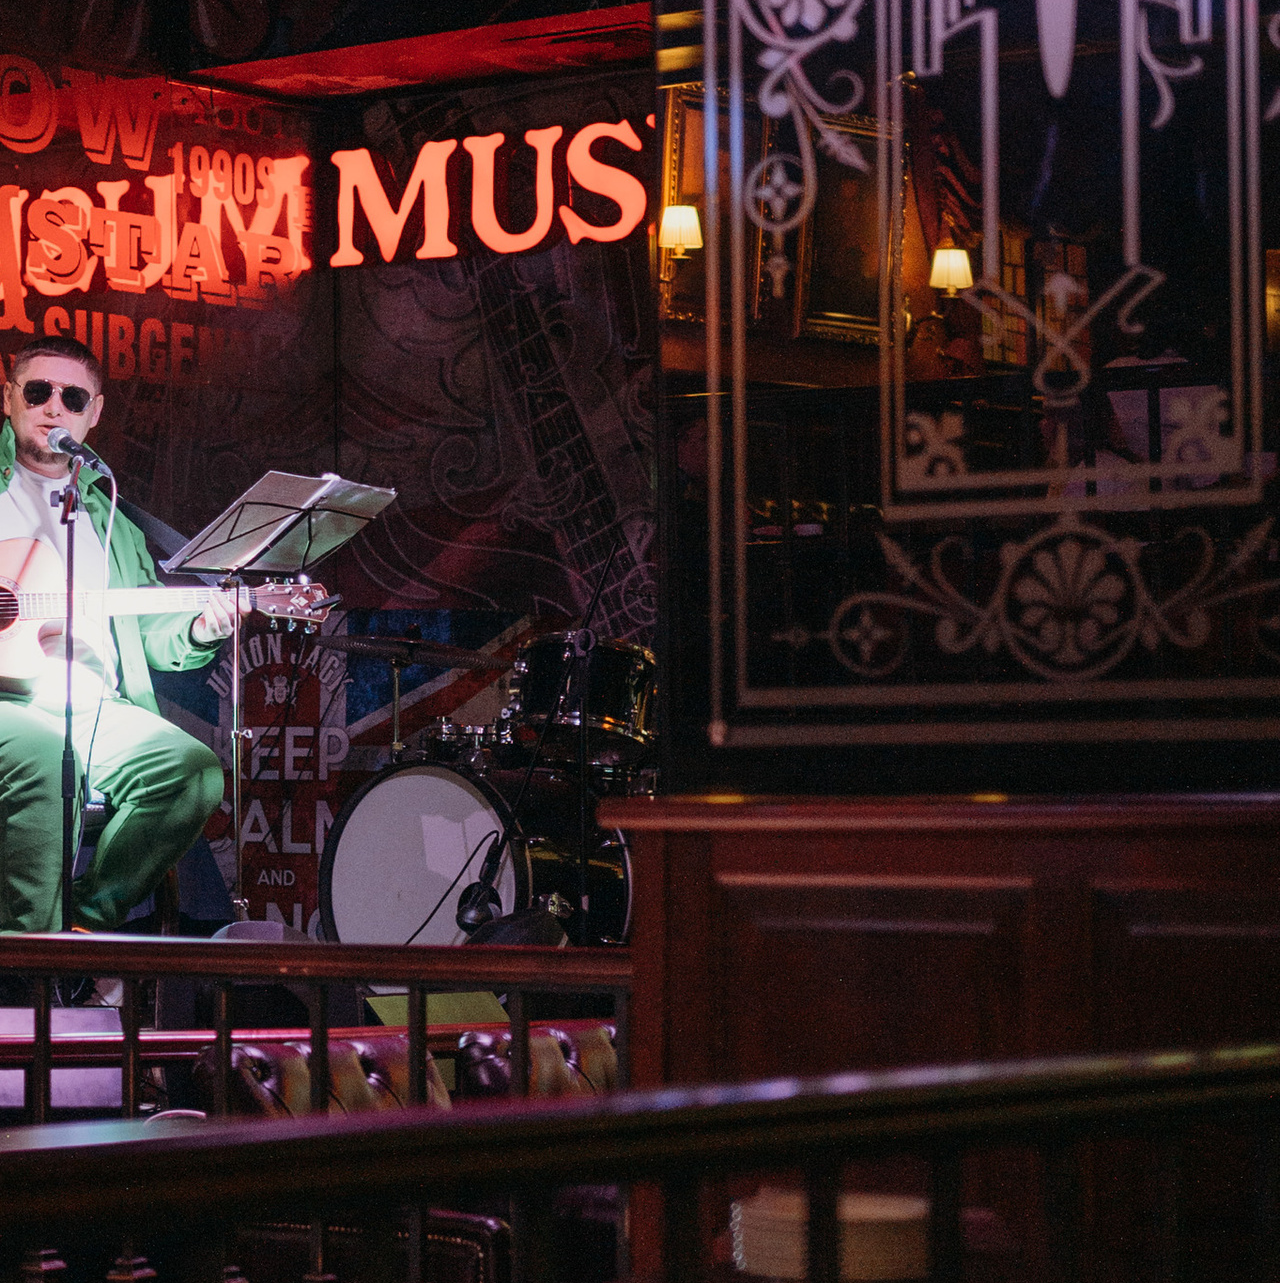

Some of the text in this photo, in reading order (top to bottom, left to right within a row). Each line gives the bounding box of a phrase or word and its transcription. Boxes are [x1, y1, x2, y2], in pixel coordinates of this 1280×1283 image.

[168, 142, 276, 210] 1990S
[329, 112, 656, 268] MUS
[26, 198, 304, 310] STAR
[206, 632, 283, 698] UNION
[213, 726, 350, 781] KEEP
[257, 869, 296, 887] AND
